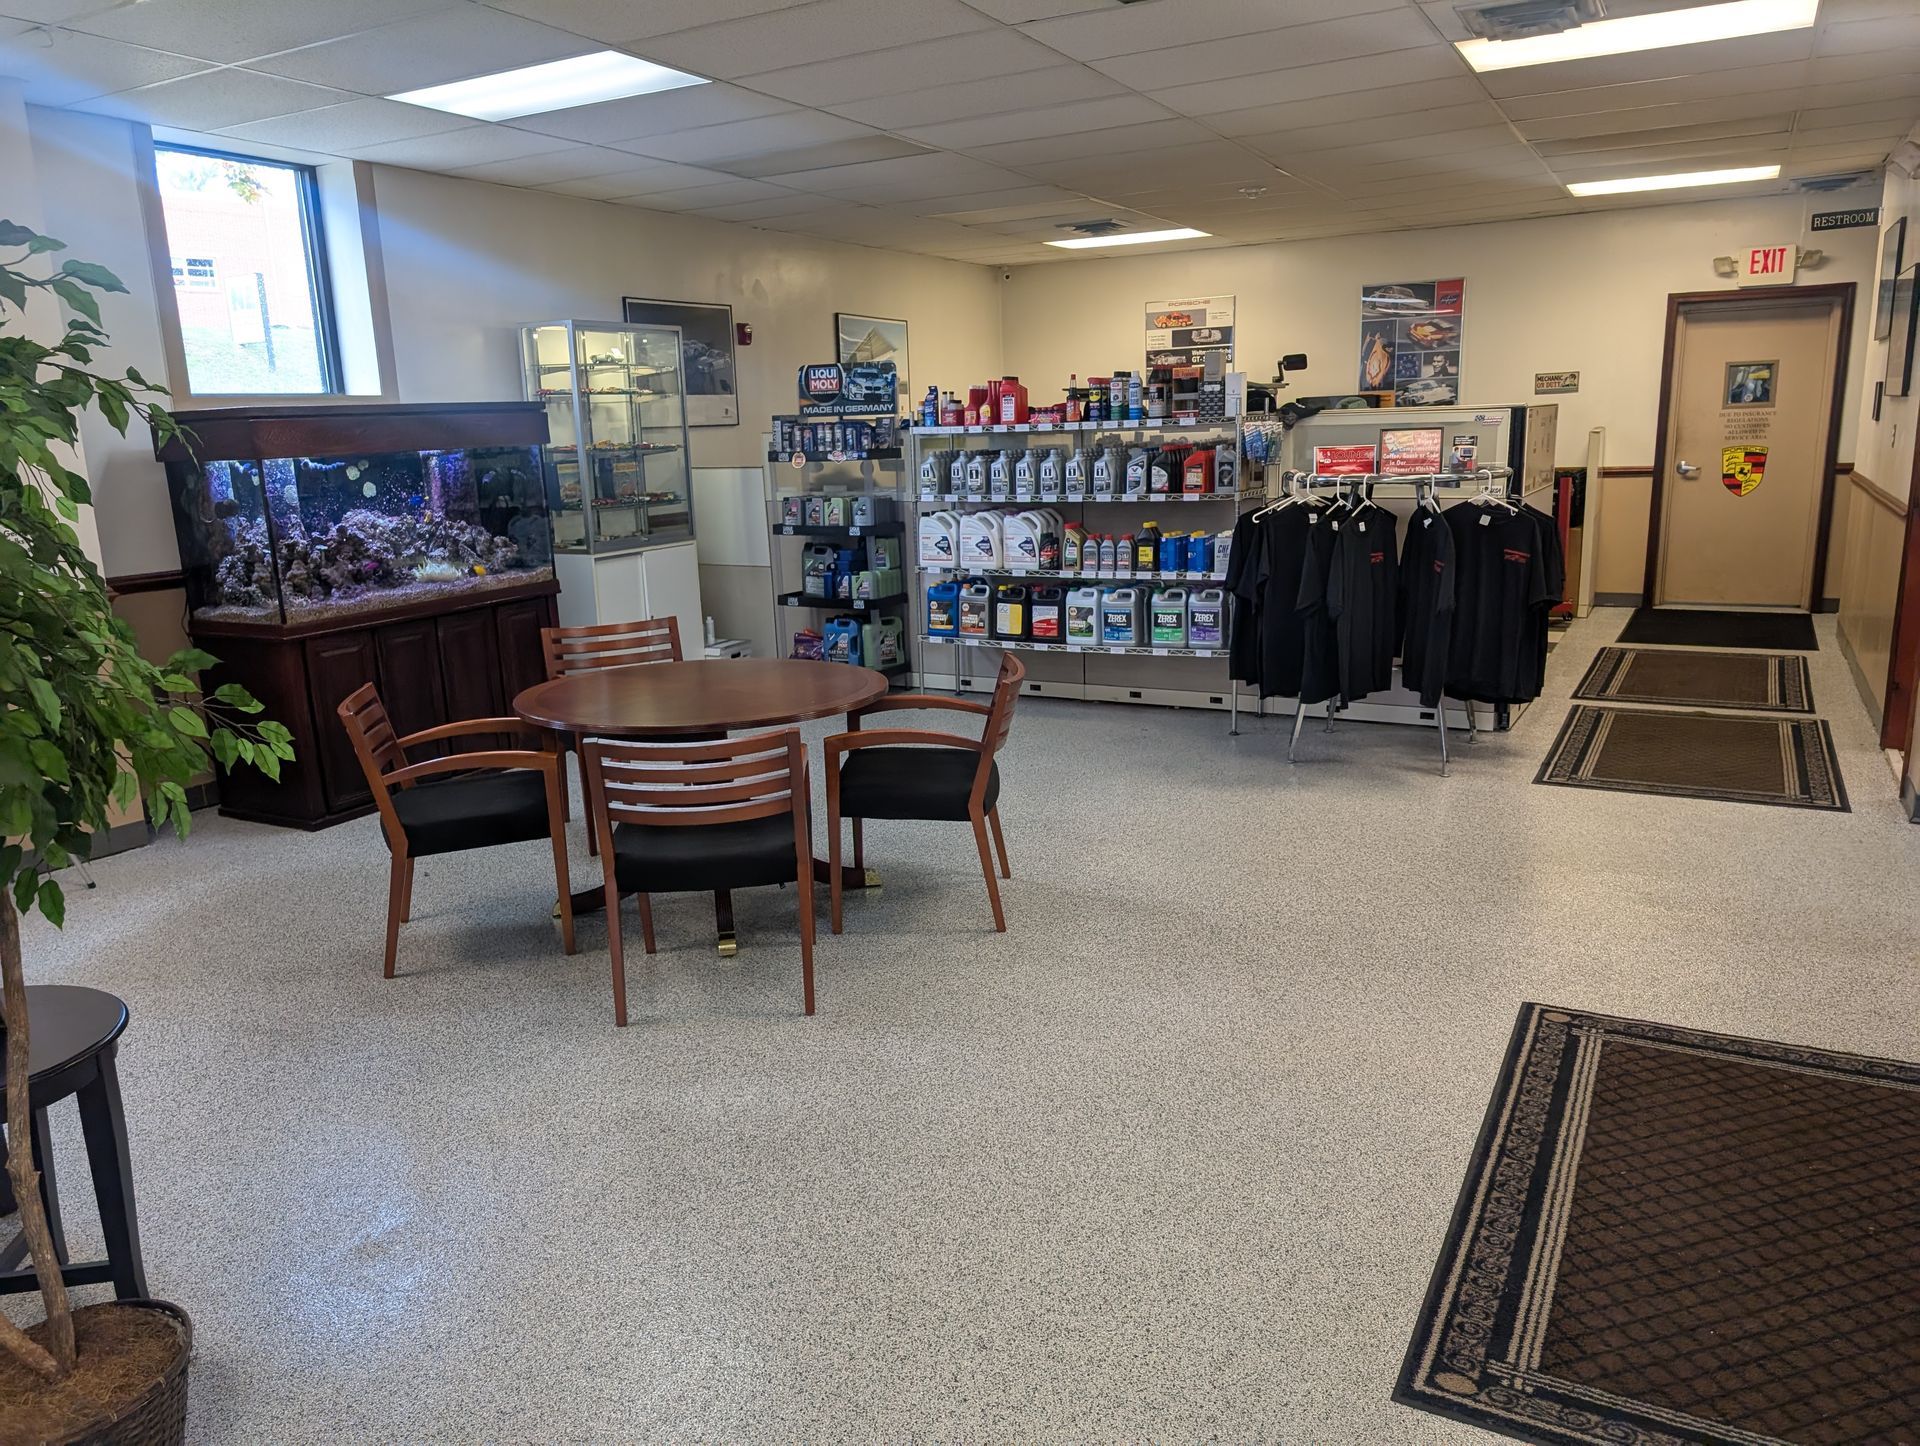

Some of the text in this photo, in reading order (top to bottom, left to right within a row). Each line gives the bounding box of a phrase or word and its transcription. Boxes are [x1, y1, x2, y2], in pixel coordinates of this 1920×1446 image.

[1814, 212, 1874, 228] RESTROOM
[1750, 248, 1787, 275] EXIT
[1168, 299, 1211, 307] PORSCHE
[810, 368, 837, 379] LIQUI
[811, 380, 838, 390] MOLY
[803, 403, 894, 414] MADE IN GERMANY
[1108, 614, 1127, 623] ZEREX
[1157, 613, 1177, 623] ZEREX
[1194, 612, 1214, 622] ZEREX
